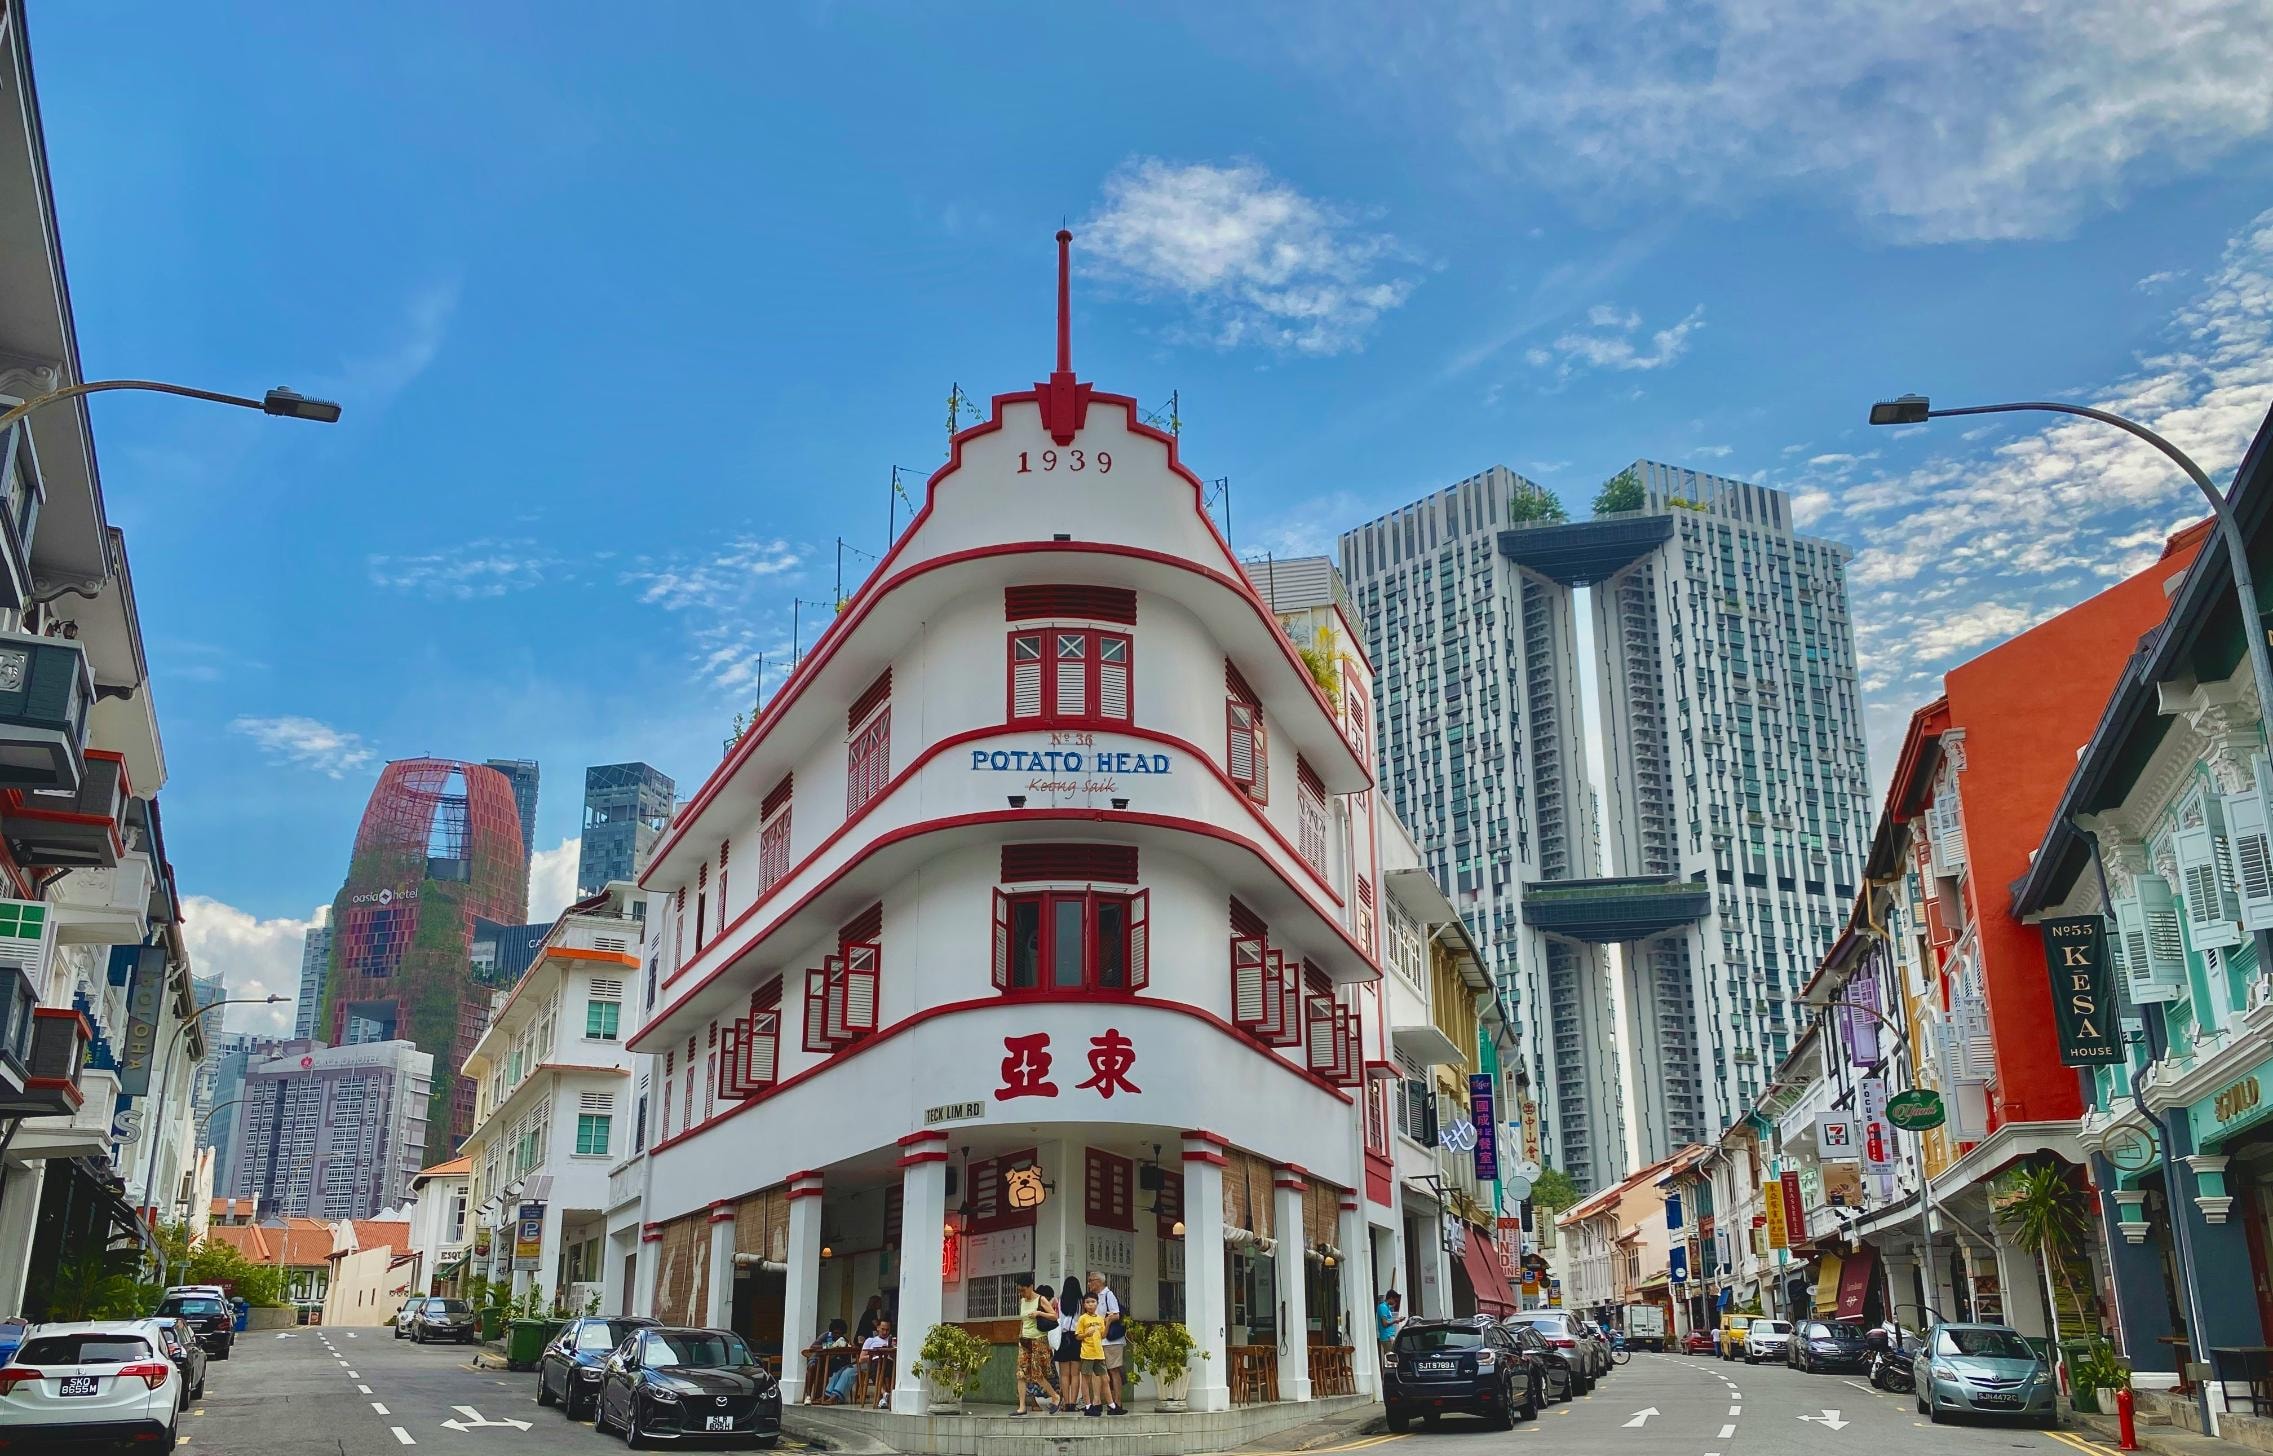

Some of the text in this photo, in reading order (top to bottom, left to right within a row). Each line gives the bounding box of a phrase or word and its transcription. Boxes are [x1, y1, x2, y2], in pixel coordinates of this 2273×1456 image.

[1017, 450, 1112, 474] 1939
[1076, 734, 1093, 746] 36
[972, 751, 1170, 774] POTATO HEAD
[1029, 778, 1076, 799] Keong
[352, 888, 418, 903] oasia hotel
[2070, 1047, 2112, 1056] HOUSE
[1863, 1082, 1873, 1122] FOCUS
[927, 1103, 980, 1123] TECK LIM RD
[1524, 1116, 1540, 1166] 中山會
[1868, 1125, 1877, 1160] MUSIC
[61, 1385, 97, 1394] 8655M
